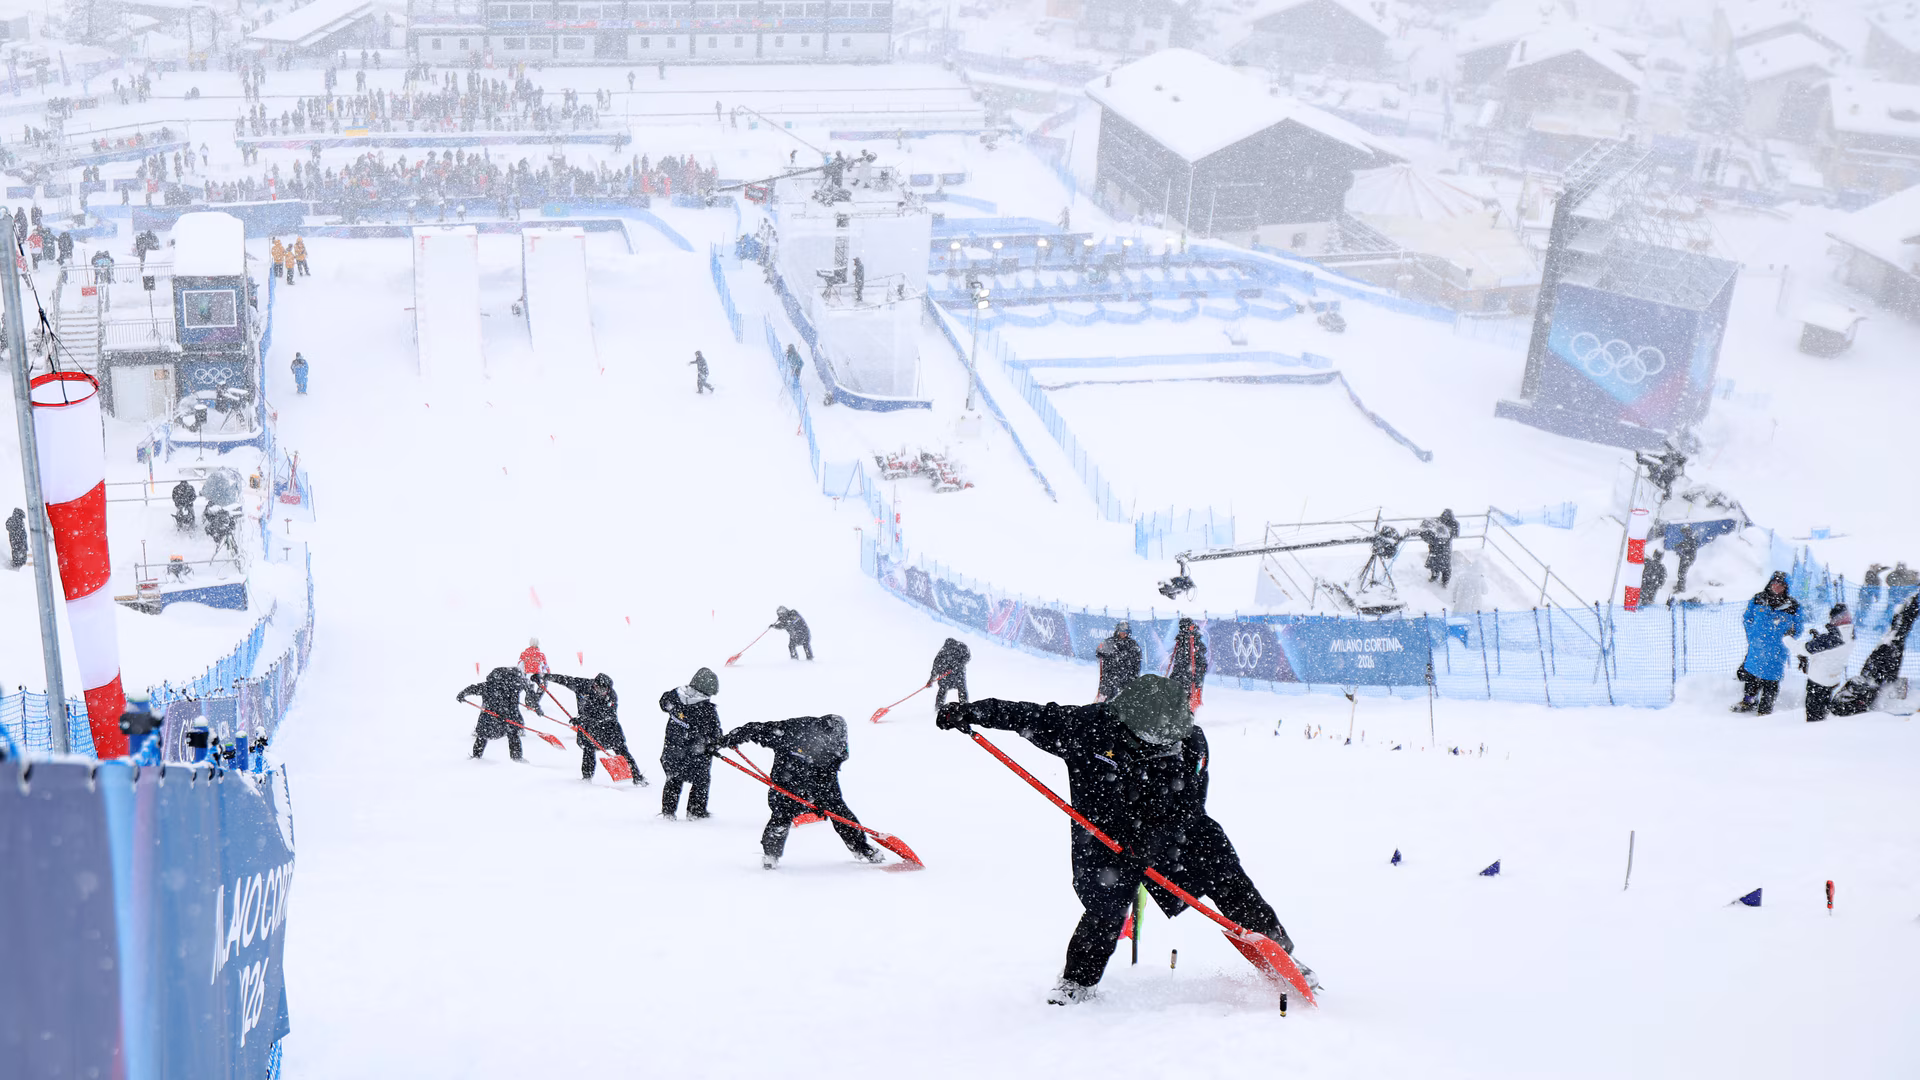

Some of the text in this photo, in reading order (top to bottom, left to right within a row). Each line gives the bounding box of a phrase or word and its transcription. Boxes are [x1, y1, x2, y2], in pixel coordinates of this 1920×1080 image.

[1329, 637, 1402, 652] MILANO CORTINA
[1357, 654, 1375, 668] 2026
